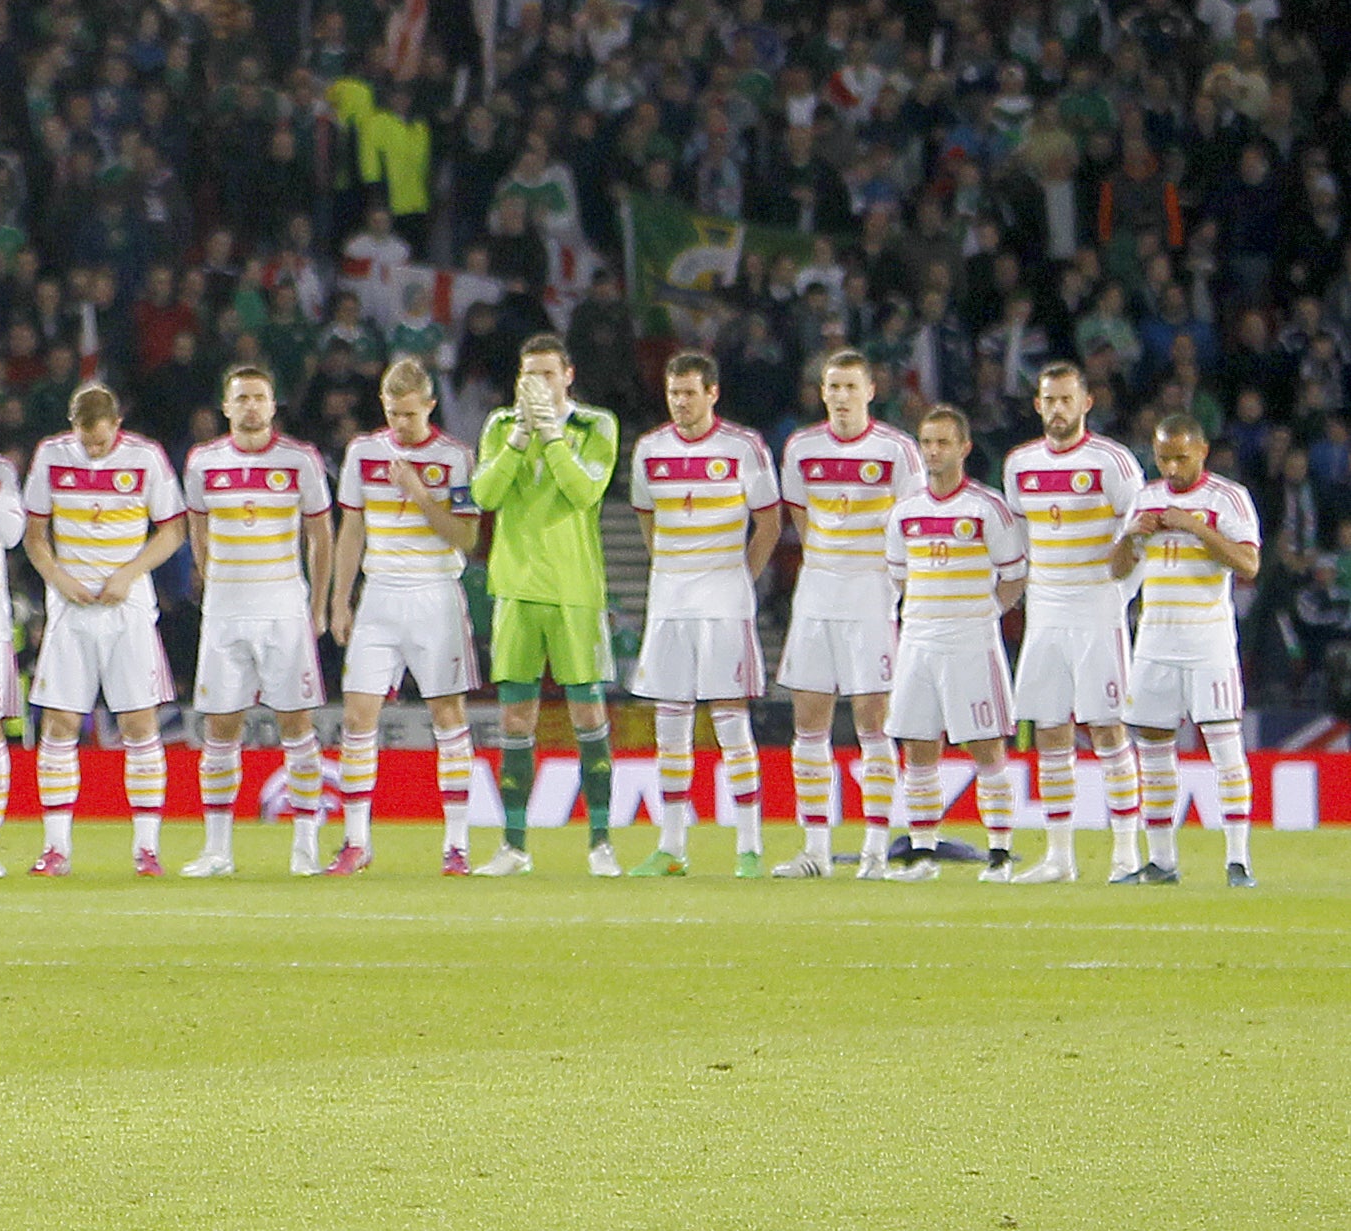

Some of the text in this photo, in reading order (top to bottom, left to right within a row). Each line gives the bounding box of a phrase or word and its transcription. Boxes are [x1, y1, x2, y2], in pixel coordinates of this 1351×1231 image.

[243, 500, 255, 527] 5
[683, 491, 693, 517] 4
[1049, 504, 1062, 530] 9
[929, 540, 947, 566] 10
[1163, 539, 1179, 567] 11
[450, 657, 461, 685] 7
[880, 654, 892, 682] 3
[301, 672, 314, 699] 5
[1106, 682, 1119, 708] 9
[1212, 681, 1229, 709] 11
[971, 700, 994, 727] 10
